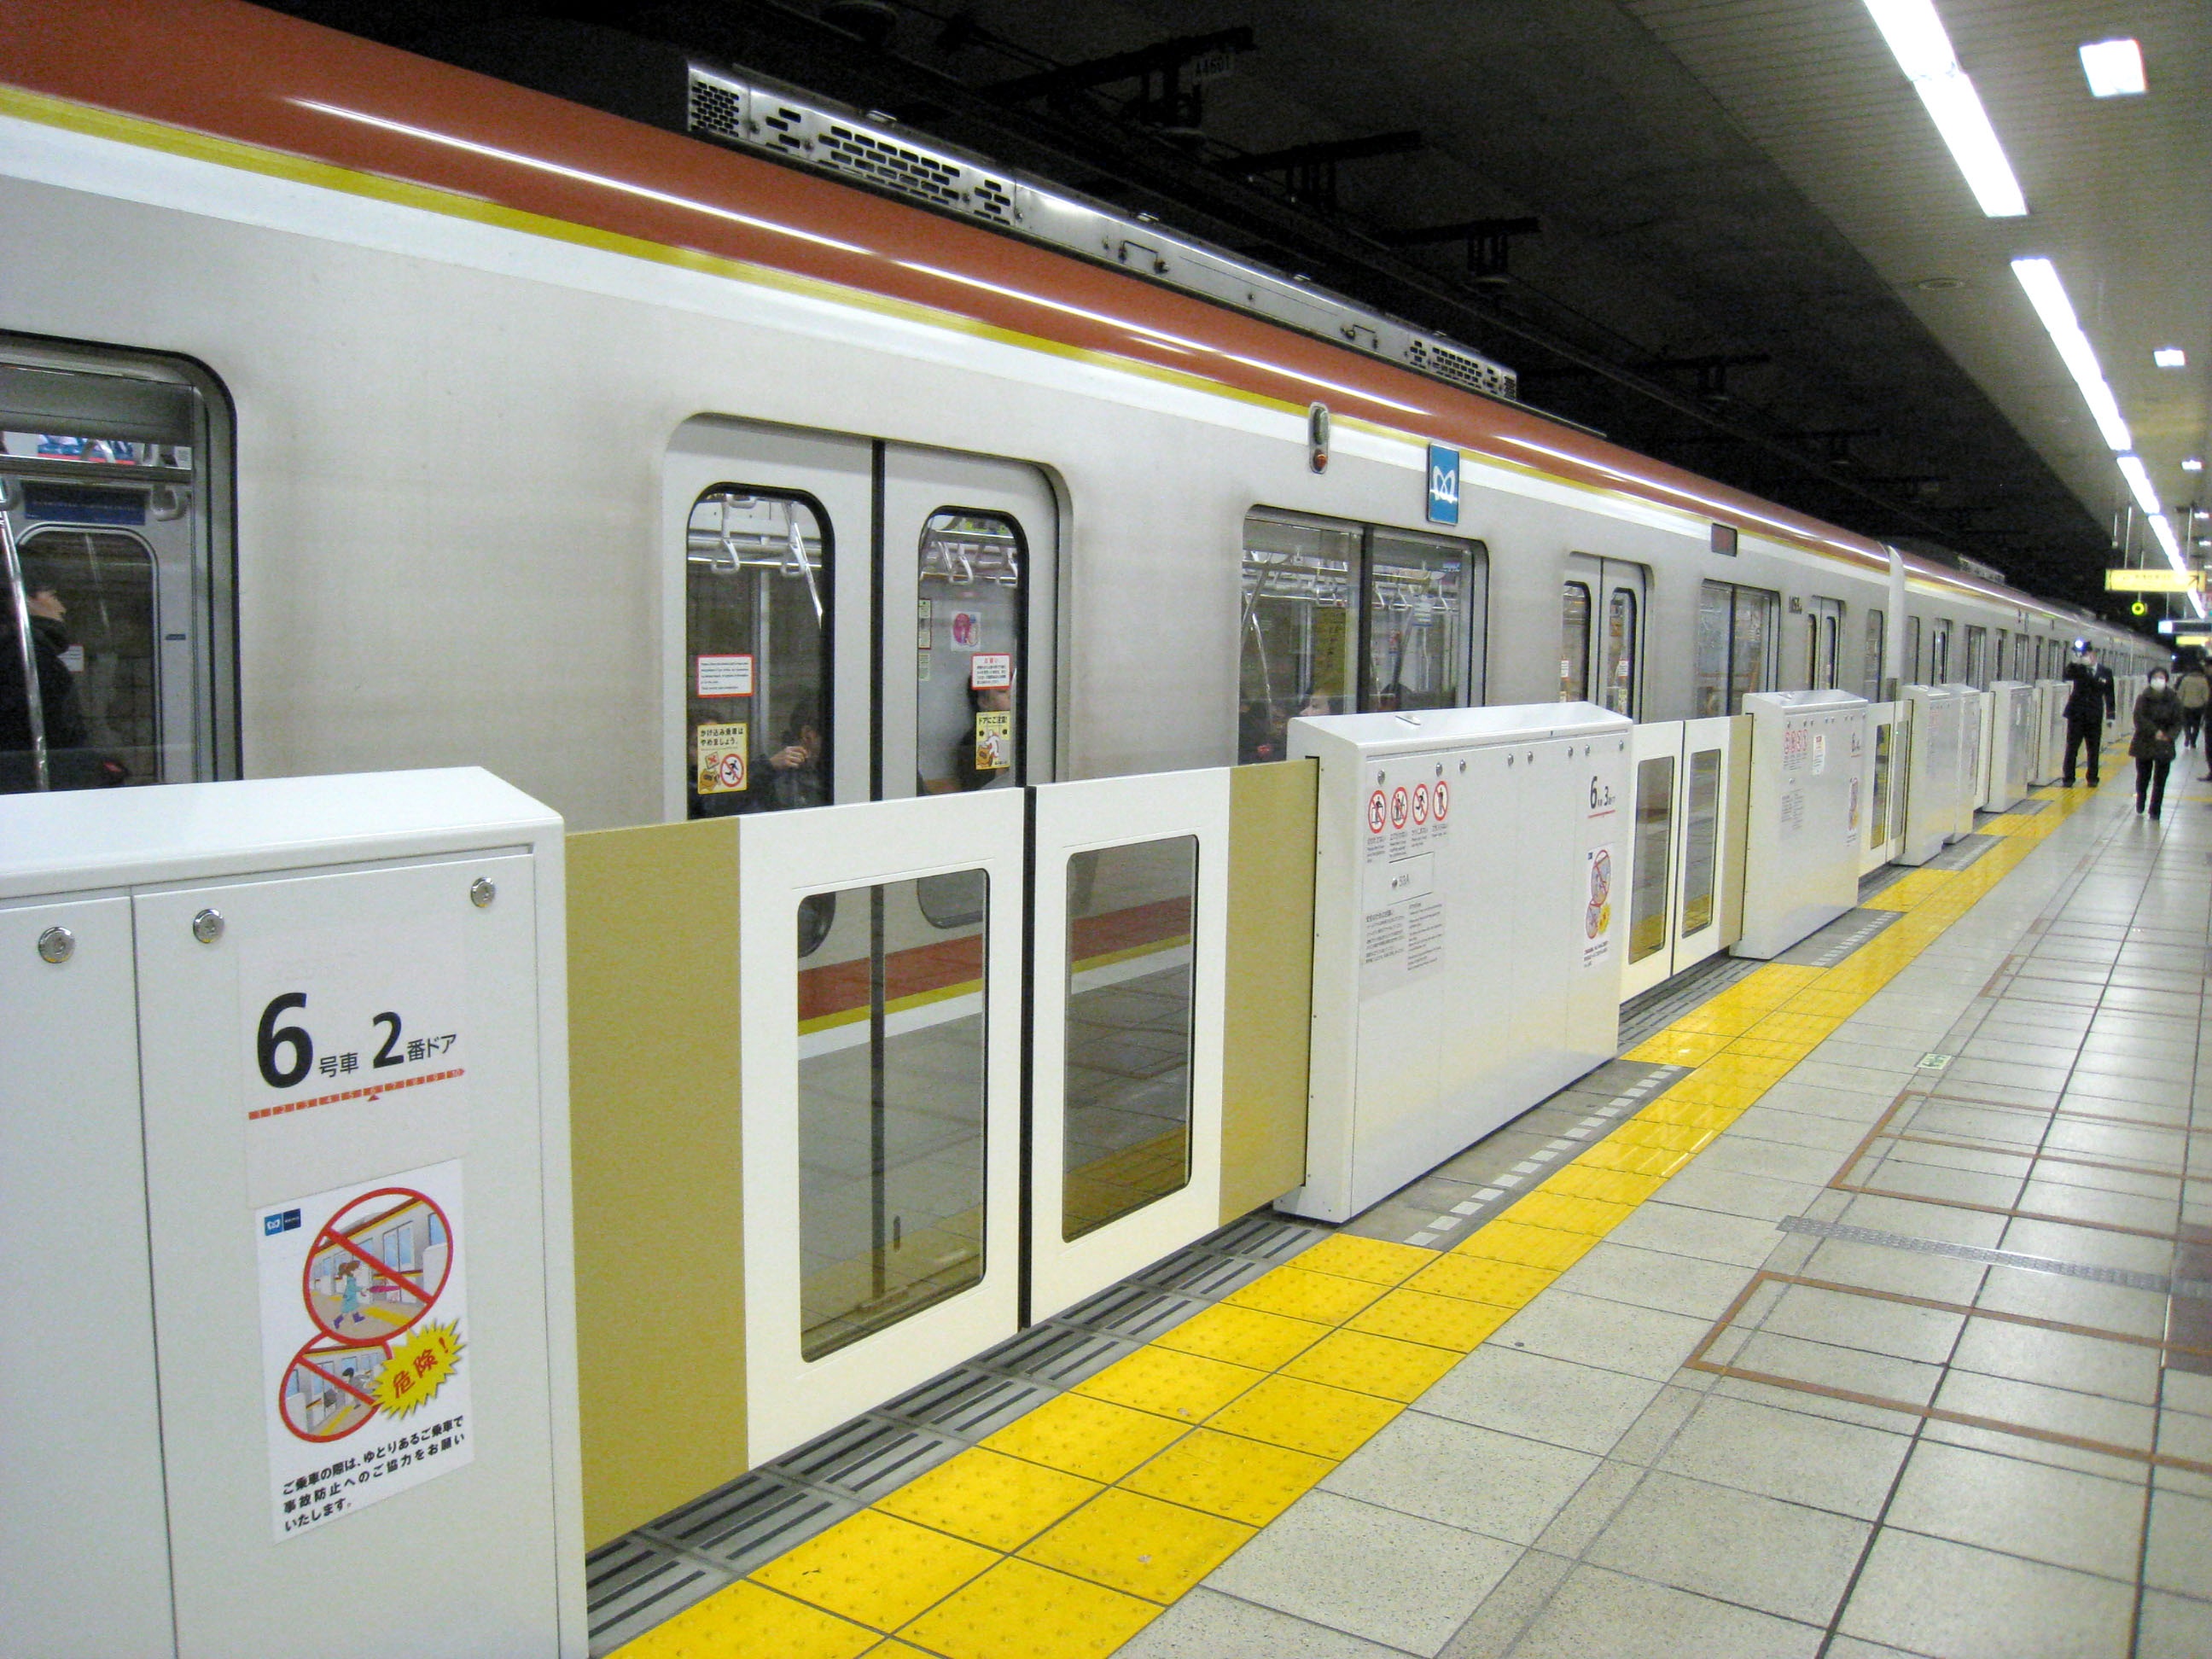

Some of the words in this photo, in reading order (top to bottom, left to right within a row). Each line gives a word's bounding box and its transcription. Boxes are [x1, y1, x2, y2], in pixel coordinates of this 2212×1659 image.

[283, 1433, 465, 1514] 事故防止へのご協力をお願い
[285, 1498, 352, 1532] いたします。
